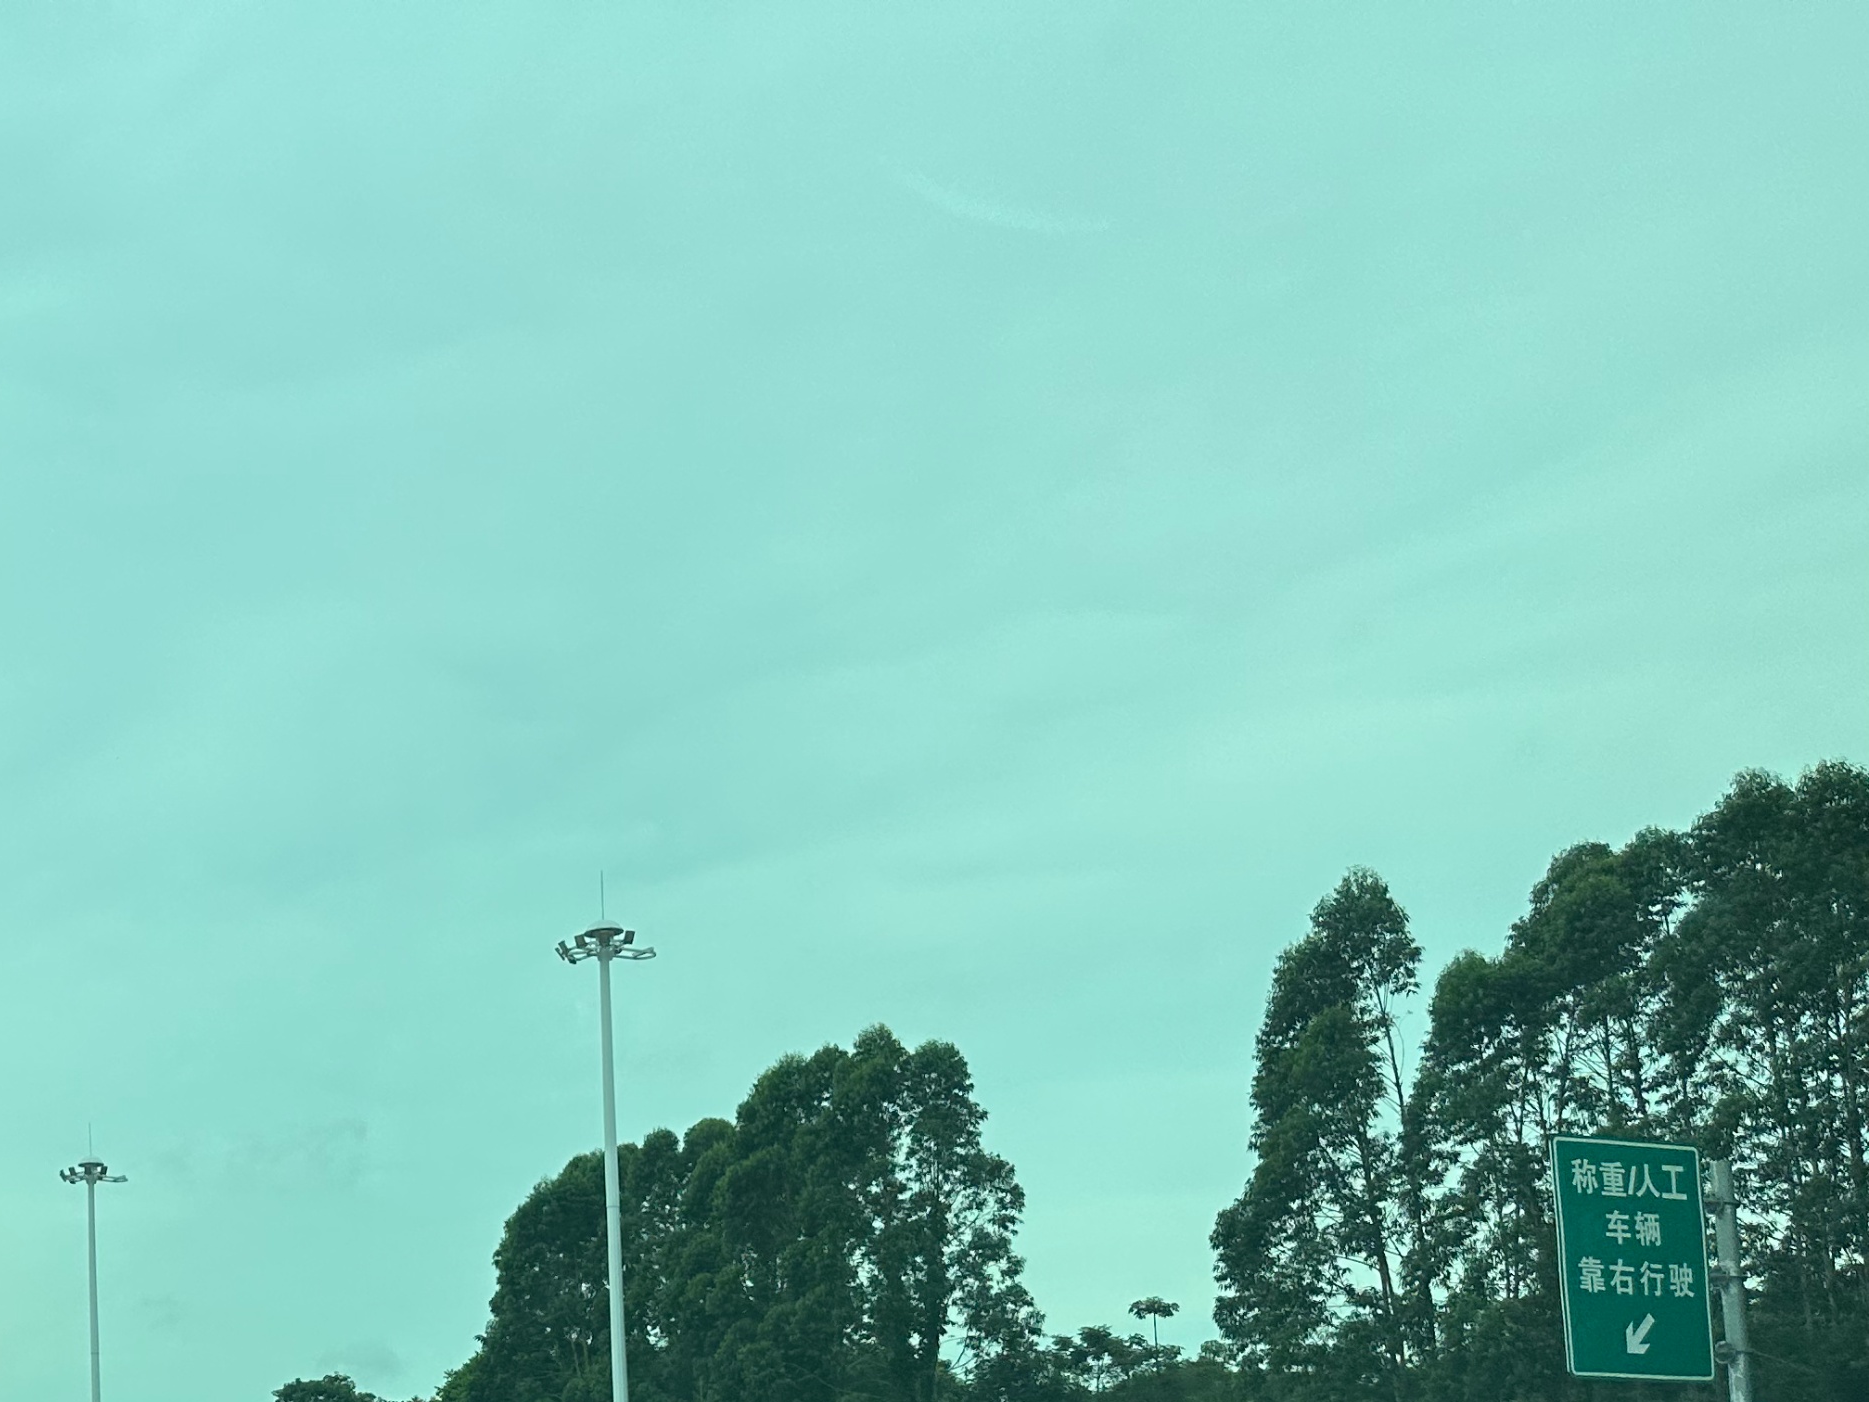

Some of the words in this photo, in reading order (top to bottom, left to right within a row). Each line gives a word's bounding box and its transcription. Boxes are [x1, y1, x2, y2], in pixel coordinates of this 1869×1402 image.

[1570, 1158, 1688, 1201] 称重/人工
[1605, 1210, 1662, 1247] 车辆
[1578, 1255, 1695, 1298] 靠右行驶
